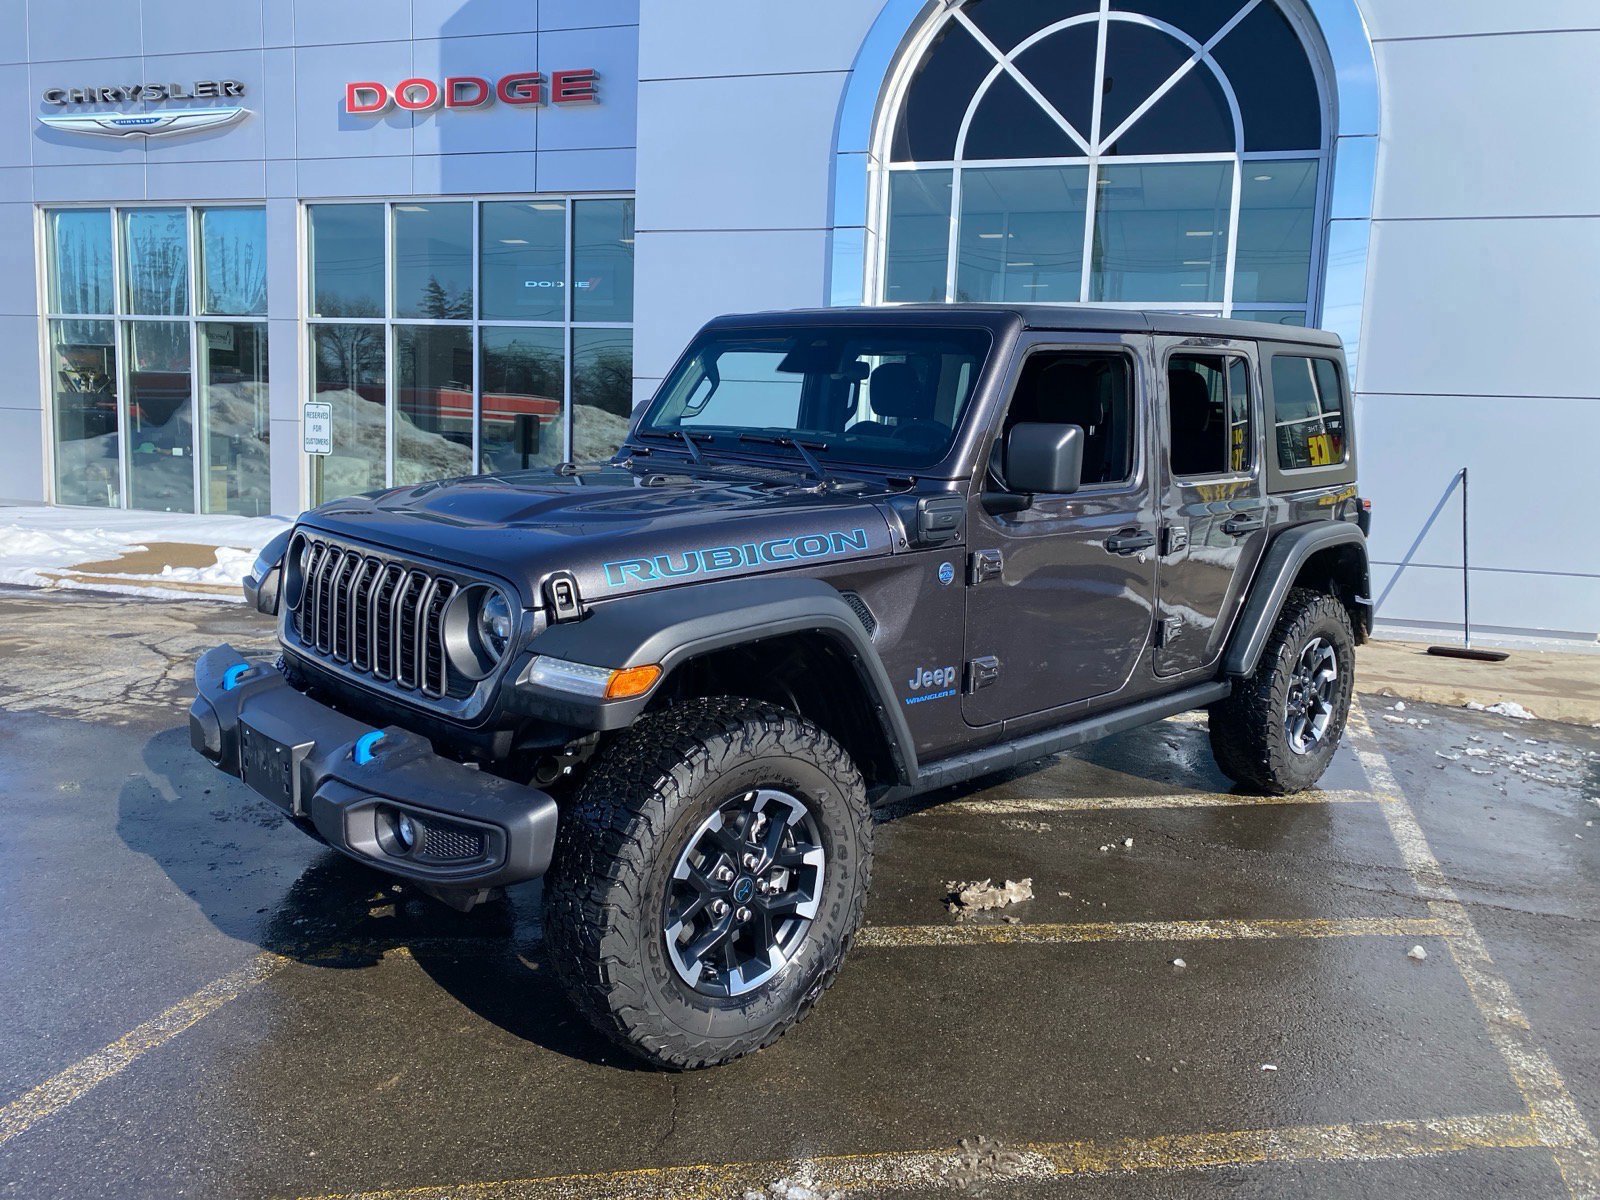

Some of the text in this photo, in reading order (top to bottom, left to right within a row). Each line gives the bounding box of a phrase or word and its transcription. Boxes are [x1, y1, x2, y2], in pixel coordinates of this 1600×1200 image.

[41, 79, 244, 104] CHRYSLER
[345, 68, 599, 113] DODGE
[306, 411, 329, 420] RESERVED
[312, 424, 322, 432] FOR
[305, 437, 329, 446] CUSTOMERS
[603, 528, 869, 588] RUBICON
[908, 666, 956, 690] Jeep
[905, 690, 949, 705] WRANGLER
